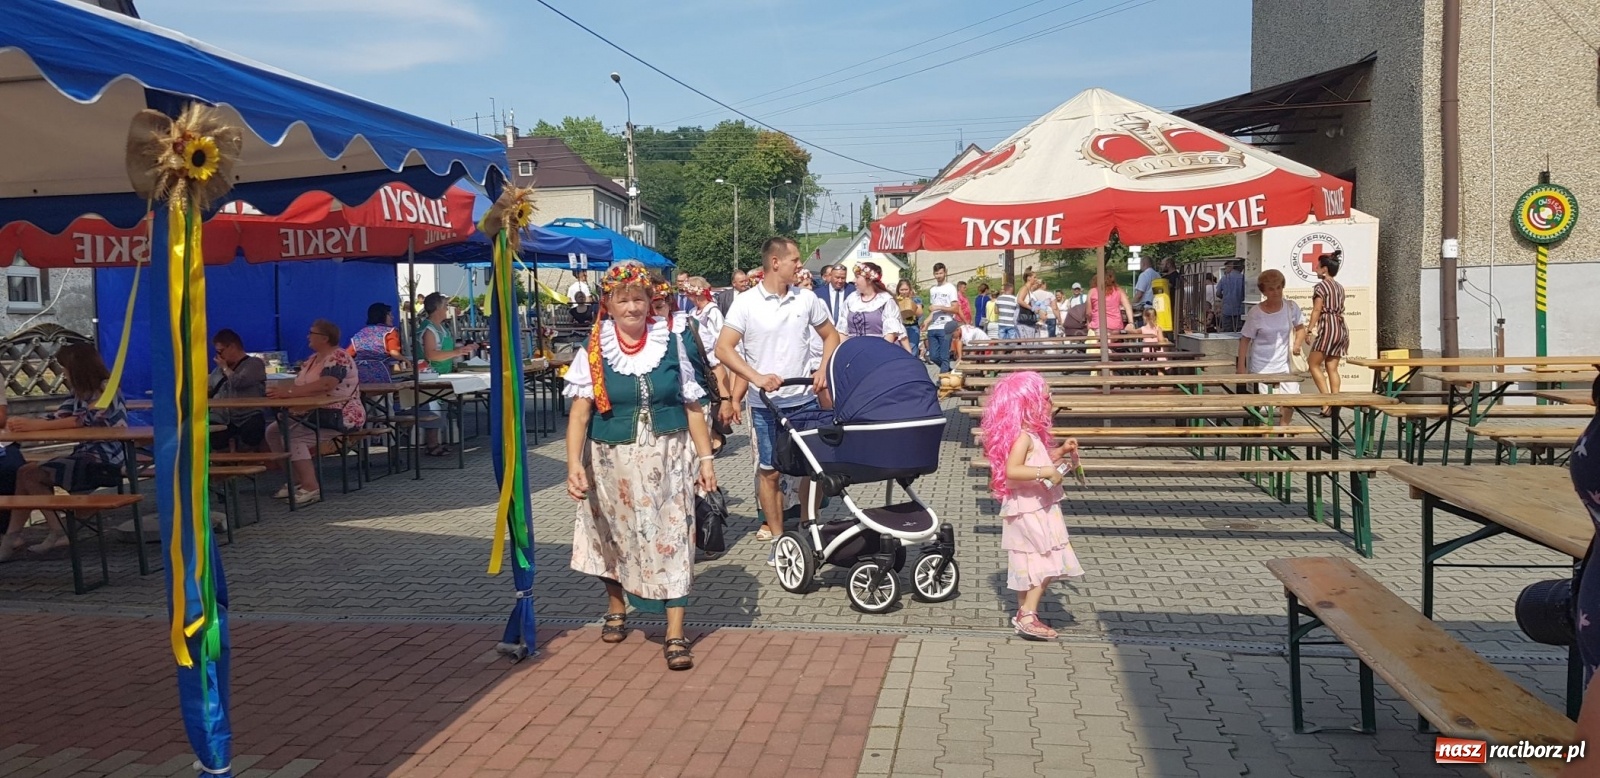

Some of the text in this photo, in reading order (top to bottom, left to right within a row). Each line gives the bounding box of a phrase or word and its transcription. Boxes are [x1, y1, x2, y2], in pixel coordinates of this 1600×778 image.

[1160, 193, 1268, 237] TYSKIE
[1321, 186, 1345, 217] TYSKIE
[878, 222, 908, 250] TYSKIE
[961, 213, 1064, 247] TYSKIE
[1297, 234, 1342, 250] CZERWONY
[1292, 252, 1309, 280] POLSKI
